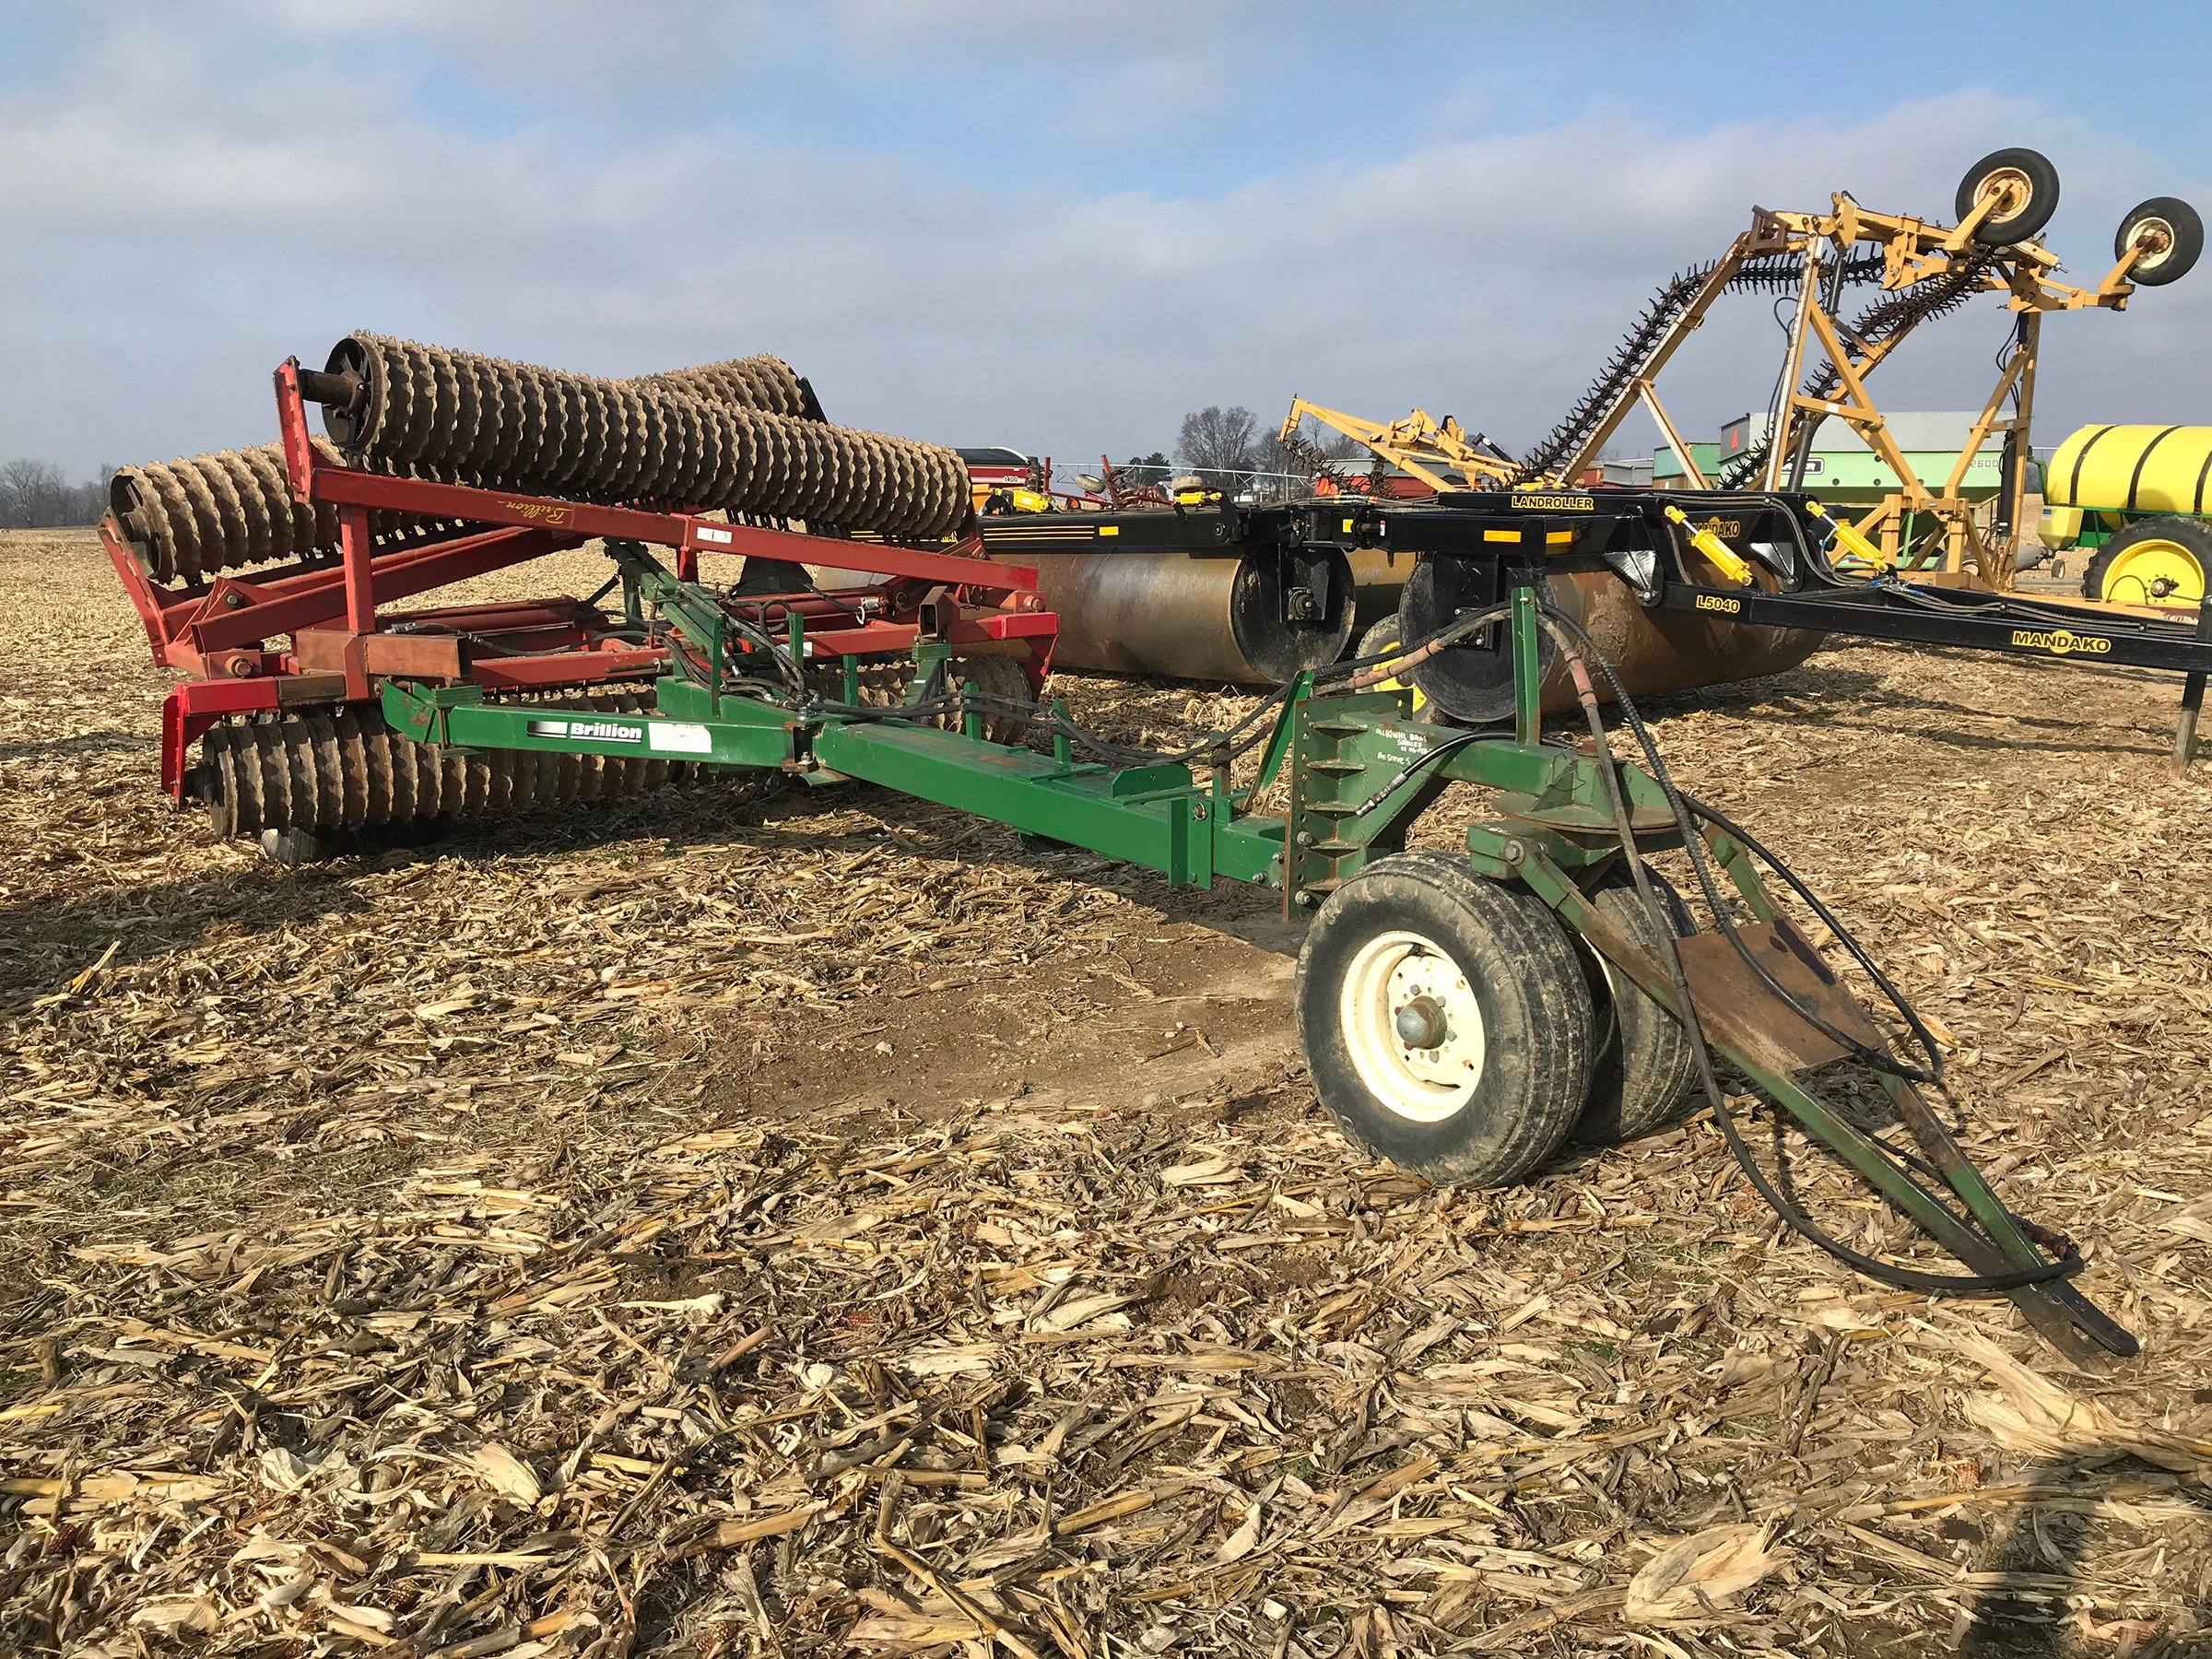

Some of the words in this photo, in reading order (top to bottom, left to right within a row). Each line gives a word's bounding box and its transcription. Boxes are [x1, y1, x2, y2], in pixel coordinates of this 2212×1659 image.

[1971, 459, 1999, 468] 2600
[497, 500, 572, 524] Brillion
[1512, 496, 1594, 511] LANDROLLER
[1696, 595, 1741, 613] L5040
[2012, 630, 2112, 654] MANDAKO
[571, 723, 642, 740] Brillion
